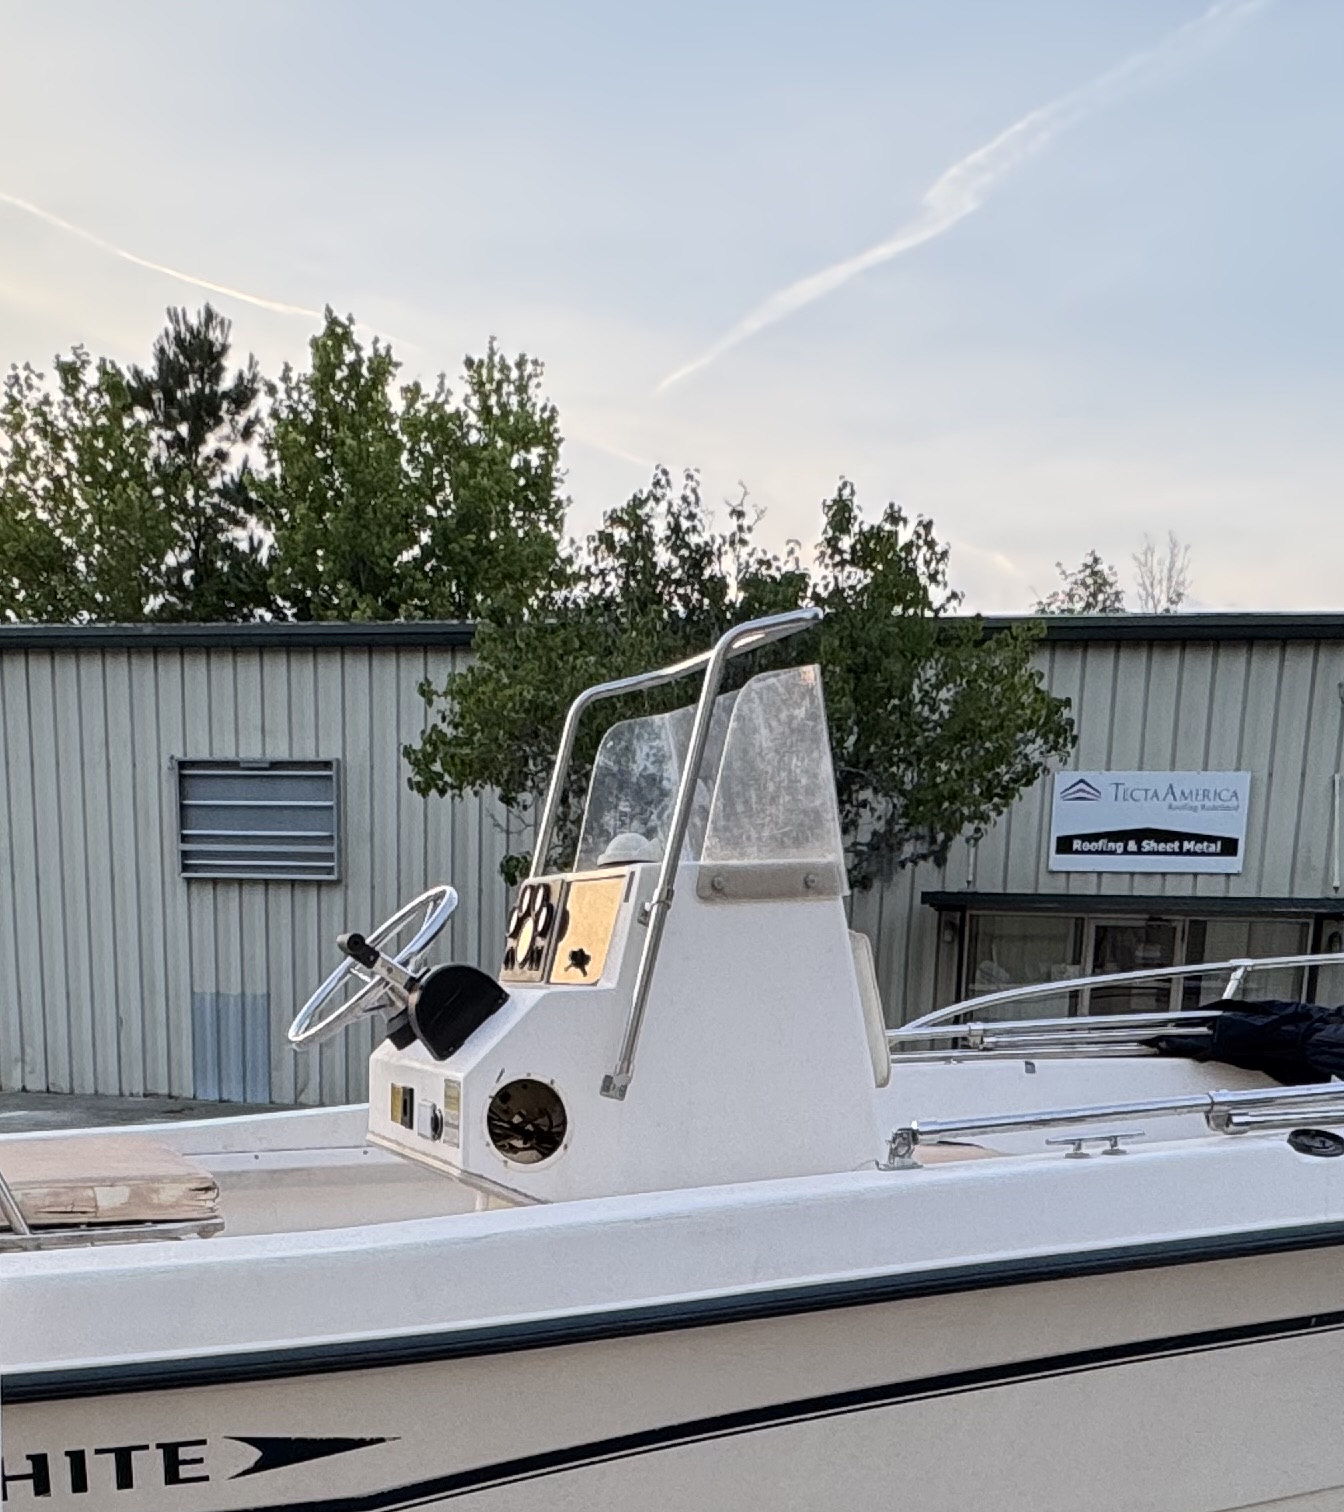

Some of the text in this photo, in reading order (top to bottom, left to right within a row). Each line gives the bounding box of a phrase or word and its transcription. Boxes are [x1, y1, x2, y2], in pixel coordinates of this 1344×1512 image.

[1072, 838, 1222, 854] Roofing & Sheet Metal
